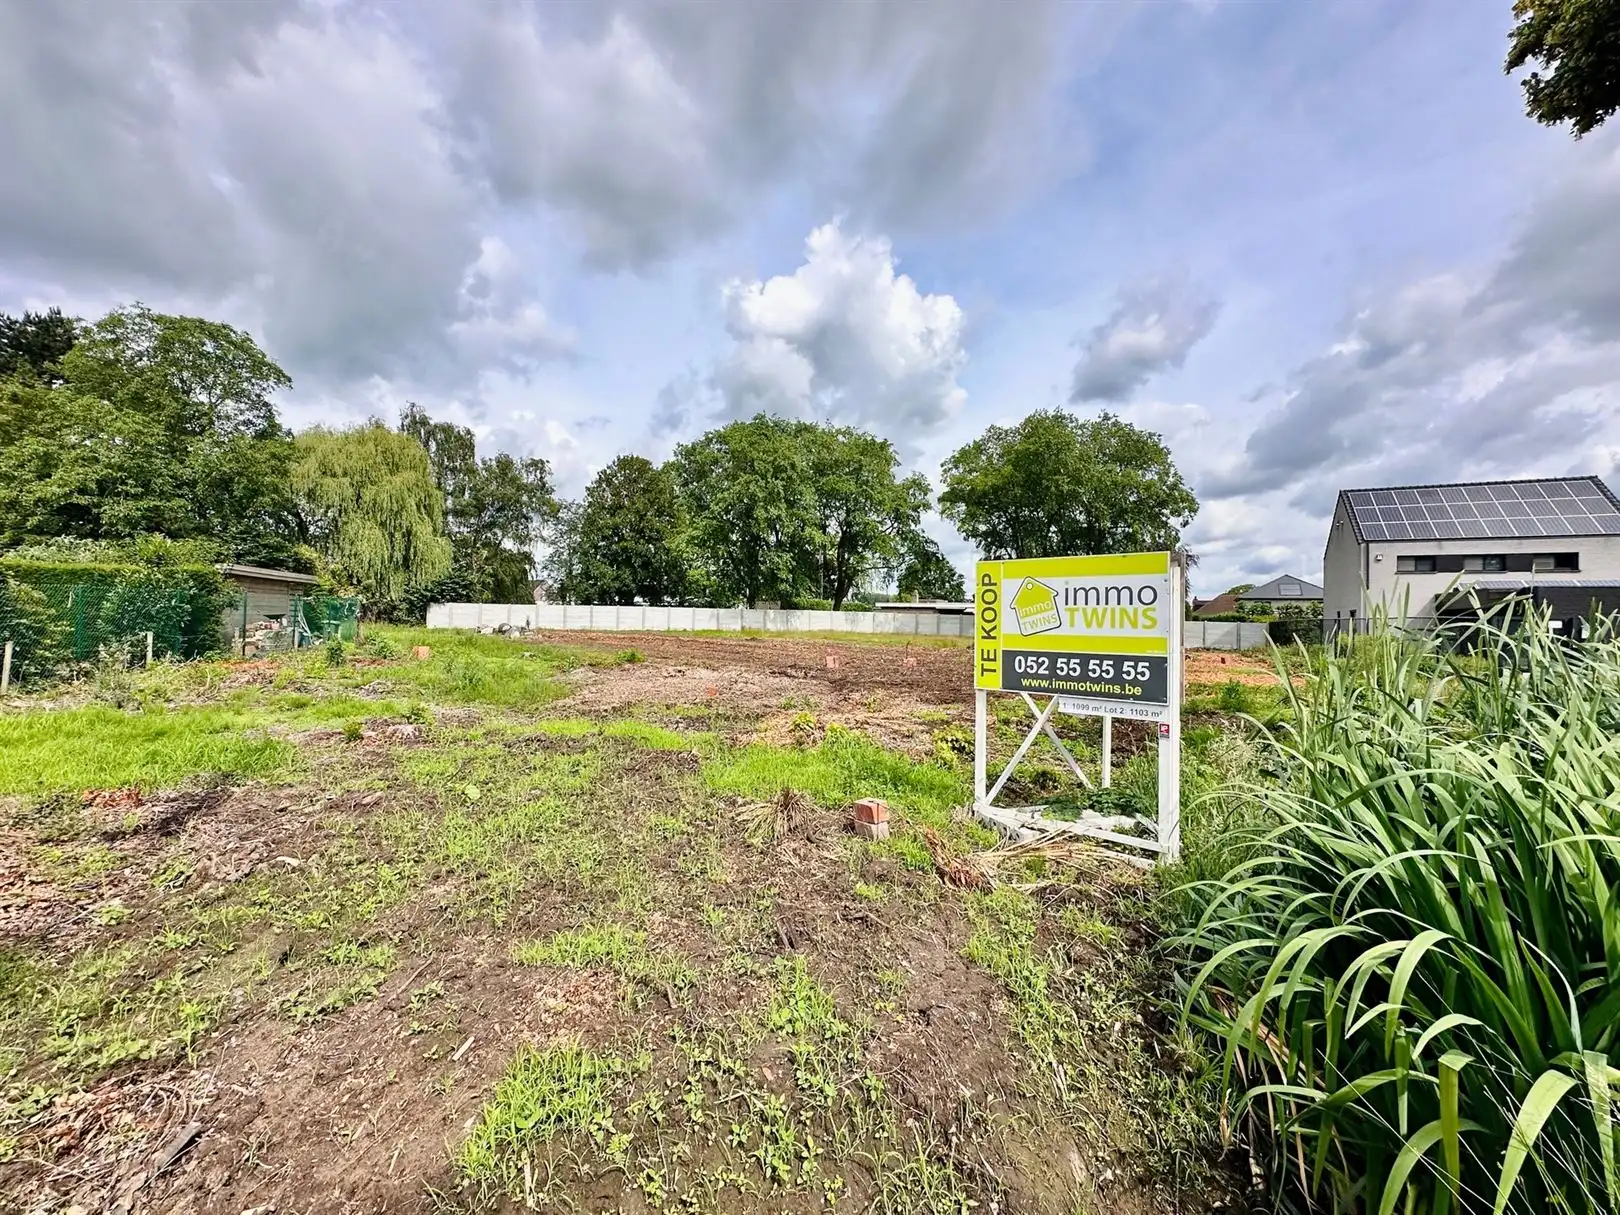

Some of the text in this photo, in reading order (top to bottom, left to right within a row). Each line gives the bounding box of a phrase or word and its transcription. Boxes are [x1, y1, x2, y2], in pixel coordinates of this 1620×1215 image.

[1064, 580, 1158, 606] immo
[1019, 600, 1052, 617] immo
[1064, 607, 1158, 630] TWINS
[981, 573, 998, 677] TE KOOP
[1021, 613, 1057, 631] TWINS
[1014, 655, 1151, 681] 052 55 55 55
[1021, 677, 1143, 696] www.immotwins.be
[1072, 703, 1090, 711] 1099
[1104, 706, 1117, 714] Lot
[1130, 708, 1149, 717] 1103
